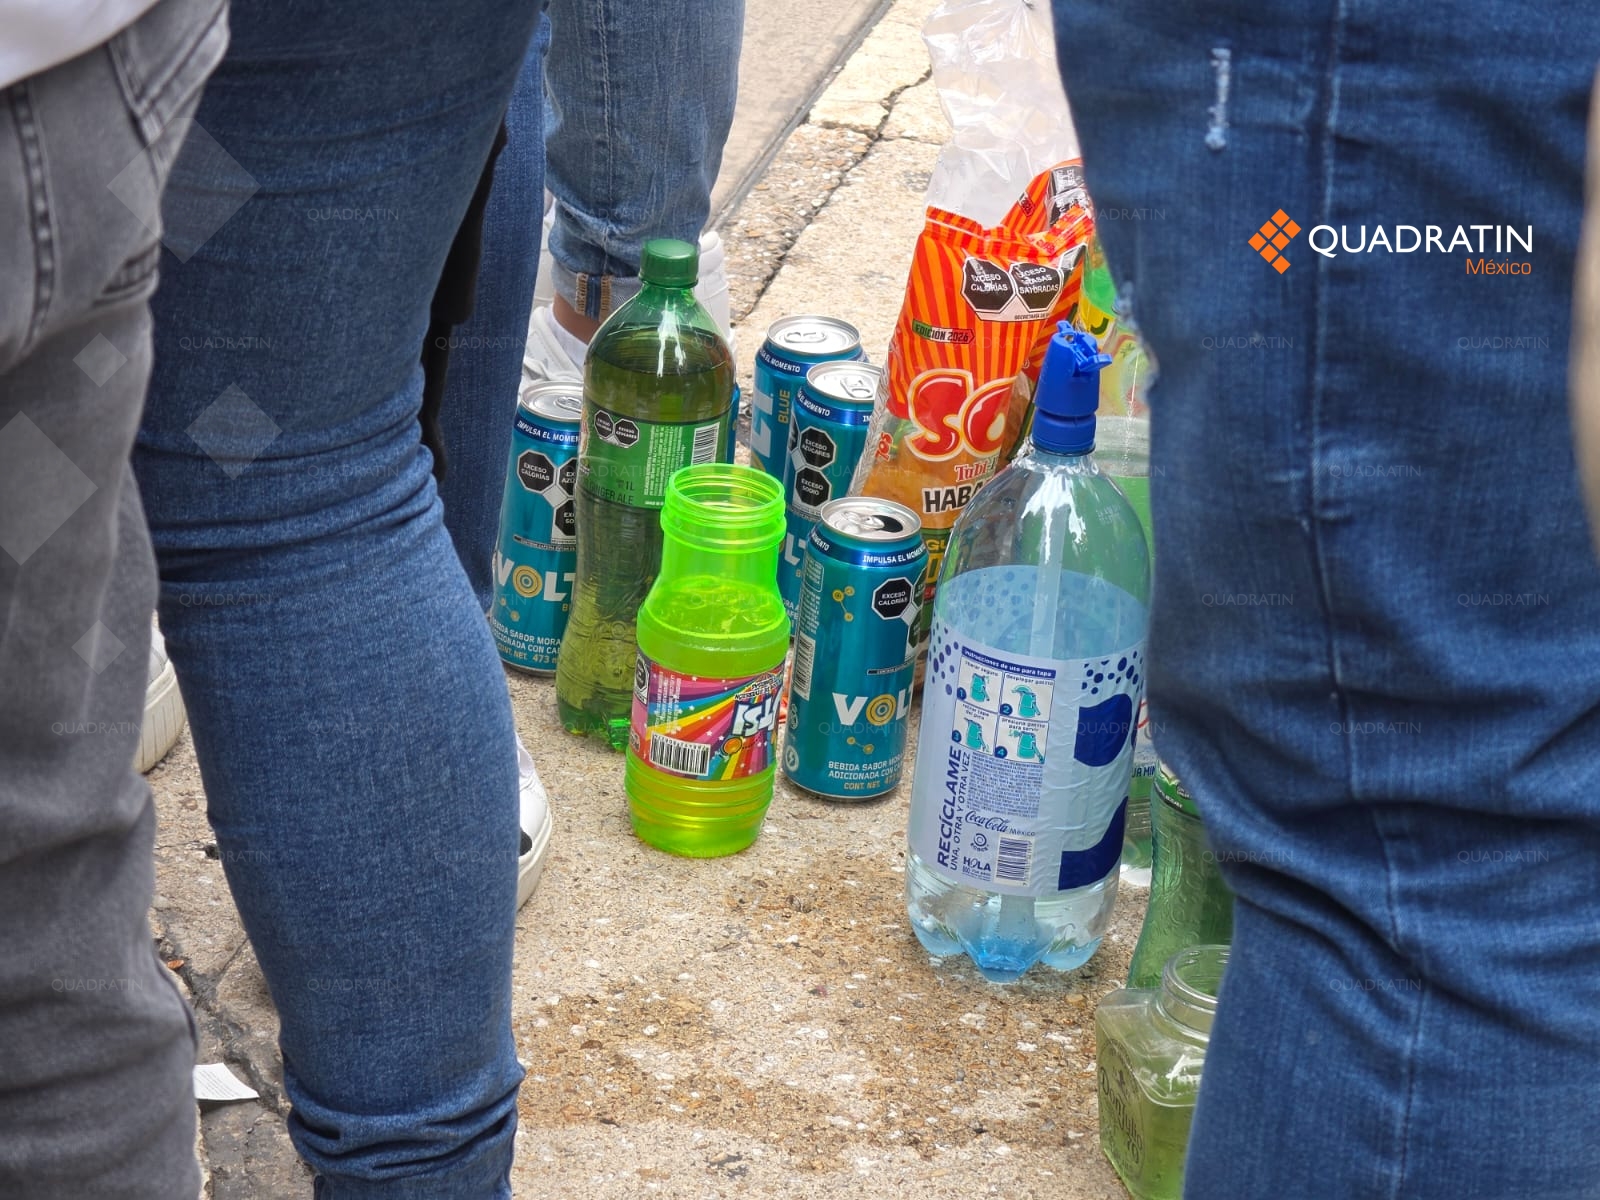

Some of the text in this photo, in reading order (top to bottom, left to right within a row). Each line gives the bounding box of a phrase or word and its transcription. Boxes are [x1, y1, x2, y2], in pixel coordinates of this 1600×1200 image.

[914, 324, 969, 342] EDICIÓN 2026
[770, 358, 801, 373] MOMENTO
[777, 390, 790, 424] BLUE
[516, 420, 541, 437] IMPULSA
[542, 431, 551, 440] EL
[804, 438, 828, 451] EXCESO
[523, 462, 547, 474] EXCESO
[800, 478, 824, 490] EXCESO
[802, 485, 820, 496] SODIO
[616, 492, 634, 505] ALE
[862, 555, 897, 564] IMPULSA
[882, 590, 906, 600] EXCESO
[510, 629, 535, 643] SABOR
[527, 644, 544, 654] CON
[532, 654, 550, 663] 473
[1000, 662, 1008, 670] de
[1021, 667, 1036, 676] para
[1036, 670, 1052, 678] tapa
[828, 761, 860, 771] BEBIDA
[862, 761, 888, 771] SABOR
[962, 752, 970, 773] VEZ
[828, 770, 880, 780] ADICIONADA
[958, 775, 968, 804] OTRA
[938, 746, 961, 868] RECÍCLAME
[954, 815, 963, 844] OTRA
[964, 856, 992, 872] HOLA
